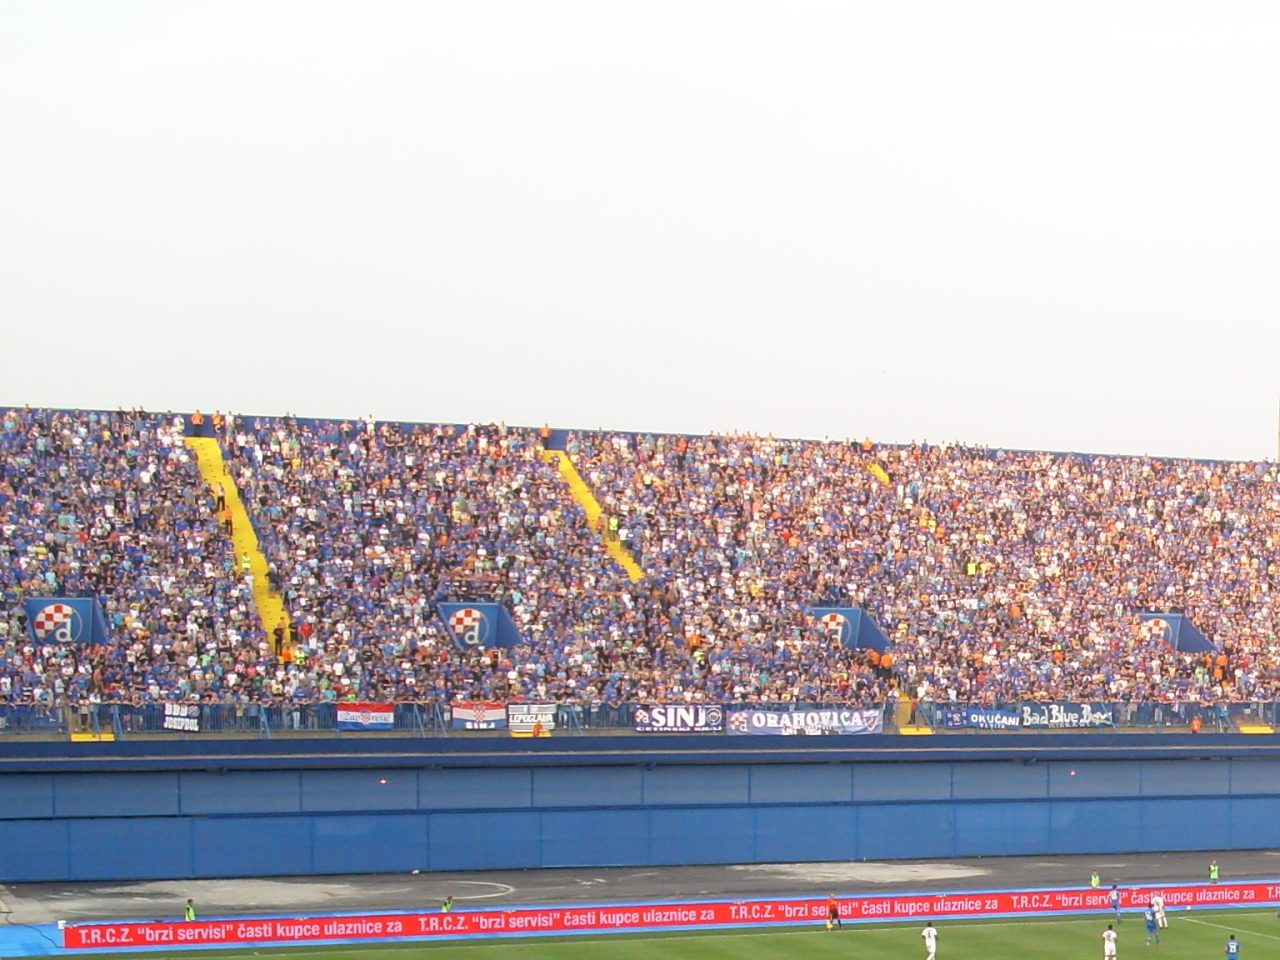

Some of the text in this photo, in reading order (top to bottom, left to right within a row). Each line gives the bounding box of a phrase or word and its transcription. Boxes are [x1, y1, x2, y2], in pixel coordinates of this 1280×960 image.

[651, 707, 706, 727] SINJ
[752, 711, 863, 728] ORAHOVICA
[1022, 706, 1049, 725] Bad
[1049, 704, 1079, 723] Blue
[729, 904, 775, 921] T.R.C.Z.
[861, 900, 890, 916] časti
[894, 899, 930, 917] kupce
[933, 897, 982, 913] ulaznice
[985, 899, 997, 911] za
[1011, 894, 1052, 910] T.R.C.Z.
[1160, 889, 1193, 907] kupce
[1195, 887, 1239, 903] ulaznice
[1243, 890, 1254, 901] za
[419, 915, 469, 933] T.R.C.Z.
[564, 910, 595, 927] časti
[600, 909, 639, 929] kupce
[643, 907, 696, 924] ulaznice
[700, 910, 713, 922] za
[79, 927, 134, 946] T.R.C.Z.
[237, 922, 271, 940] časti
[277, 920, 320, 941] kupce
[324, 918, 381, 936] ulaznice
[387, 921, 402, 934] za
